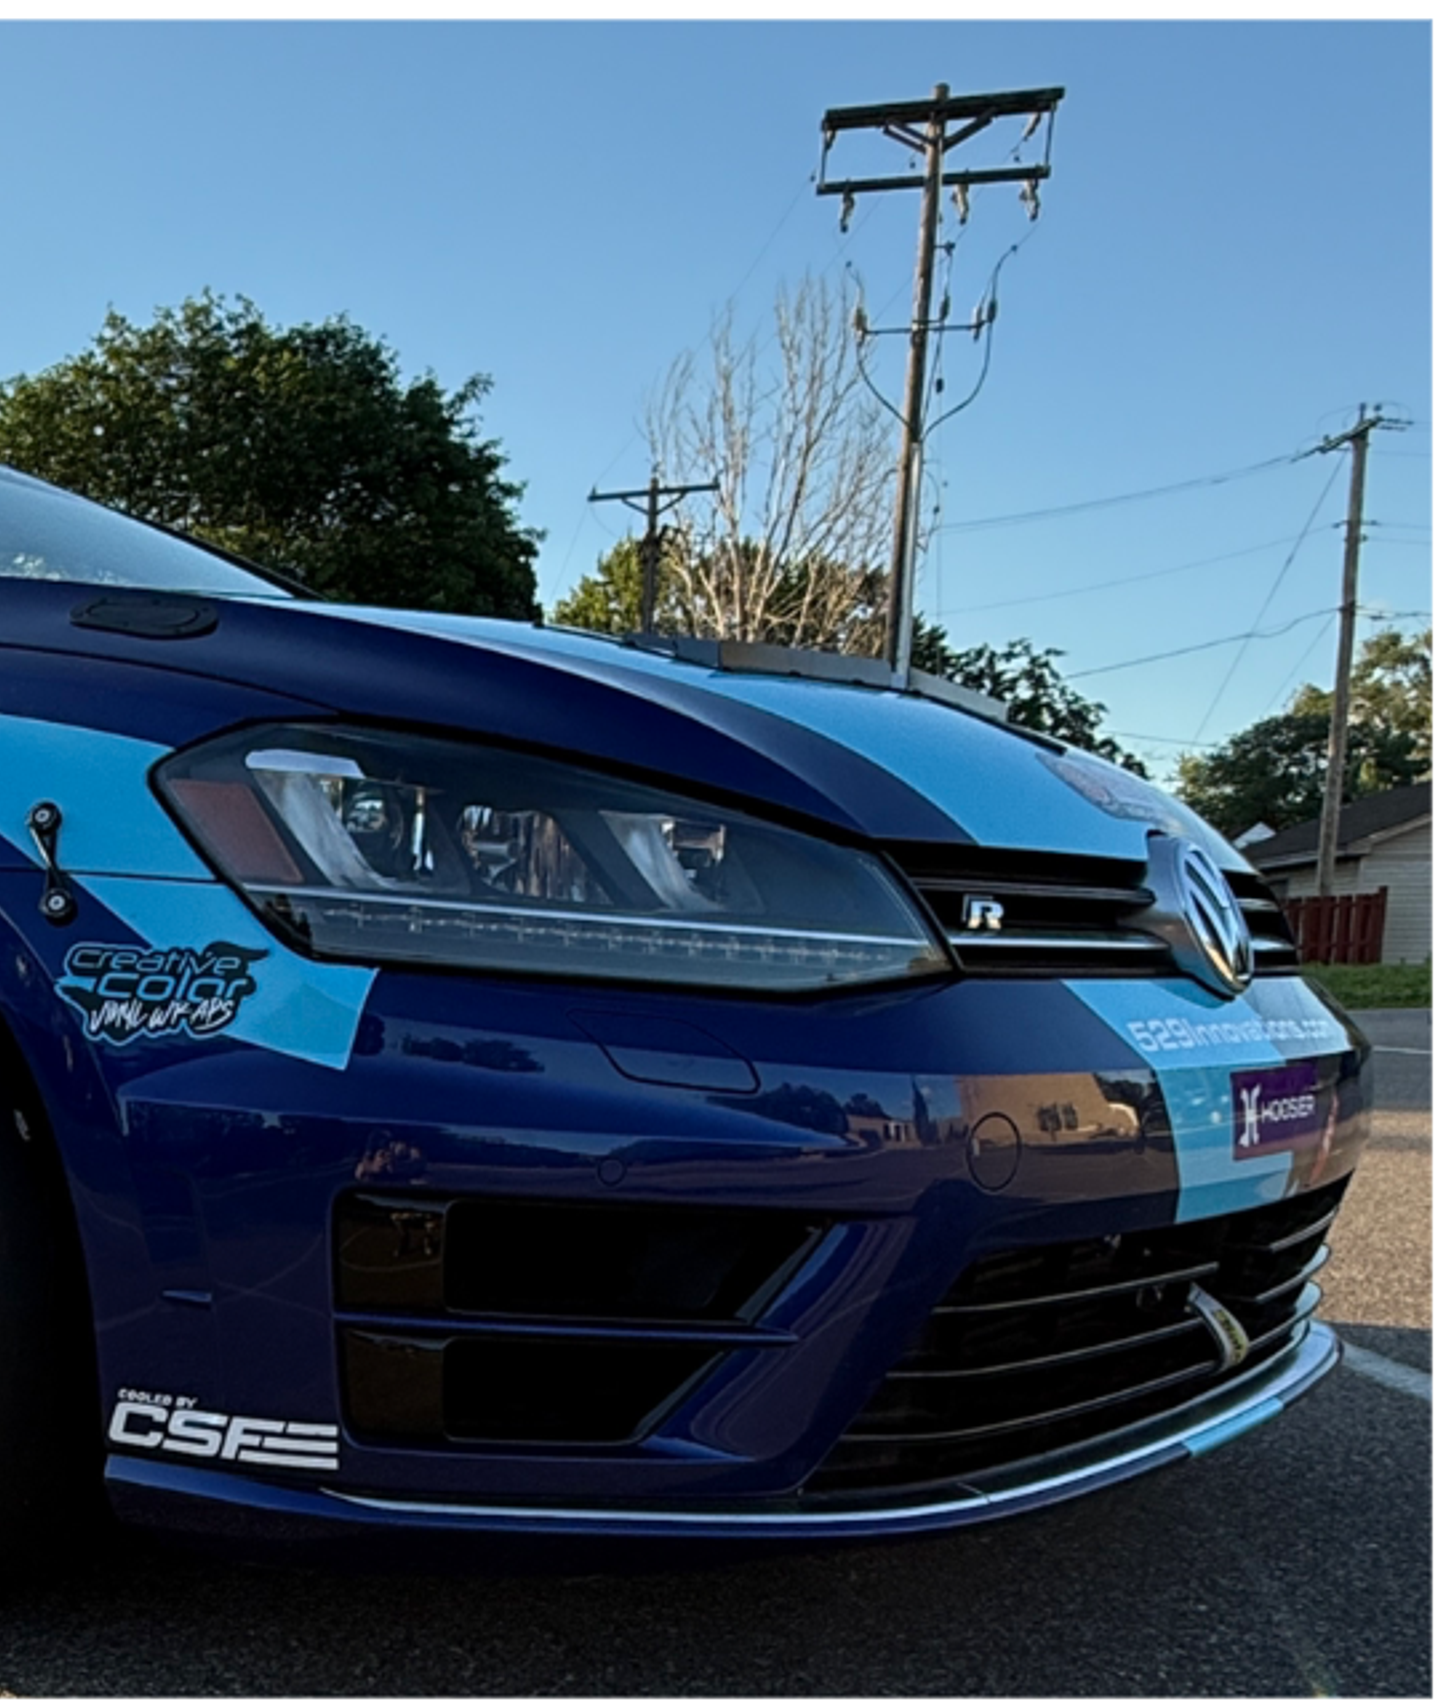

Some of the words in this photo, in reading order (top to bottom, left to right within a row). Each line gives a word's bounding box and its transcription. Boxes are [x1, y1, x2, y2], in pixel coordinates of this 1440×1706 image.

[965, 897, 1005, 930] R
[118, 1388, 172, 1407] COOLED
[175, 1396, 198, 1409] BY
